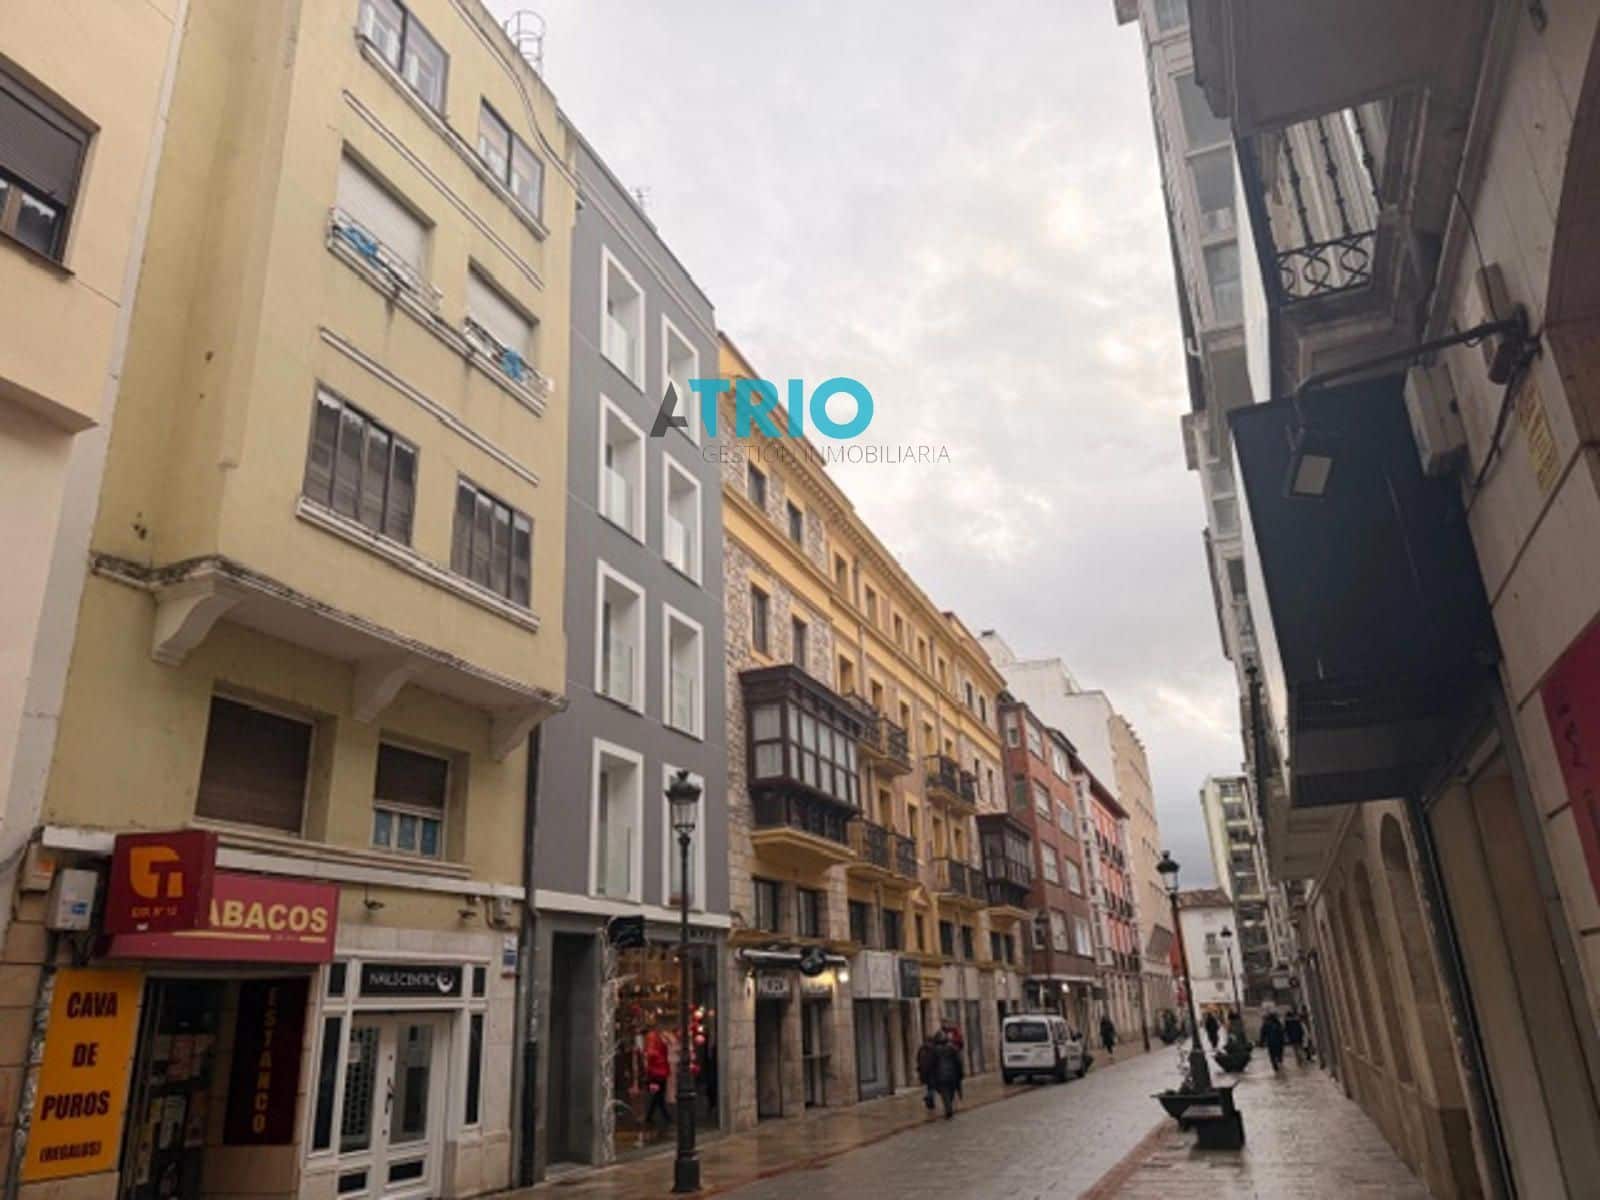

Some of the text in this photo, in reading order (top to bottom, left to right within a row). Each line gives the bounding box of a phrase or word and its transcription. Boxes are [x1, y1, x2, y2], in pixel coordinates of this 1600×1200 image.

[66, 991, 118, 1019] CAVA
[71, 1042, 98, 1068] DE
[40, 1090, 111, 1121] PUROS
